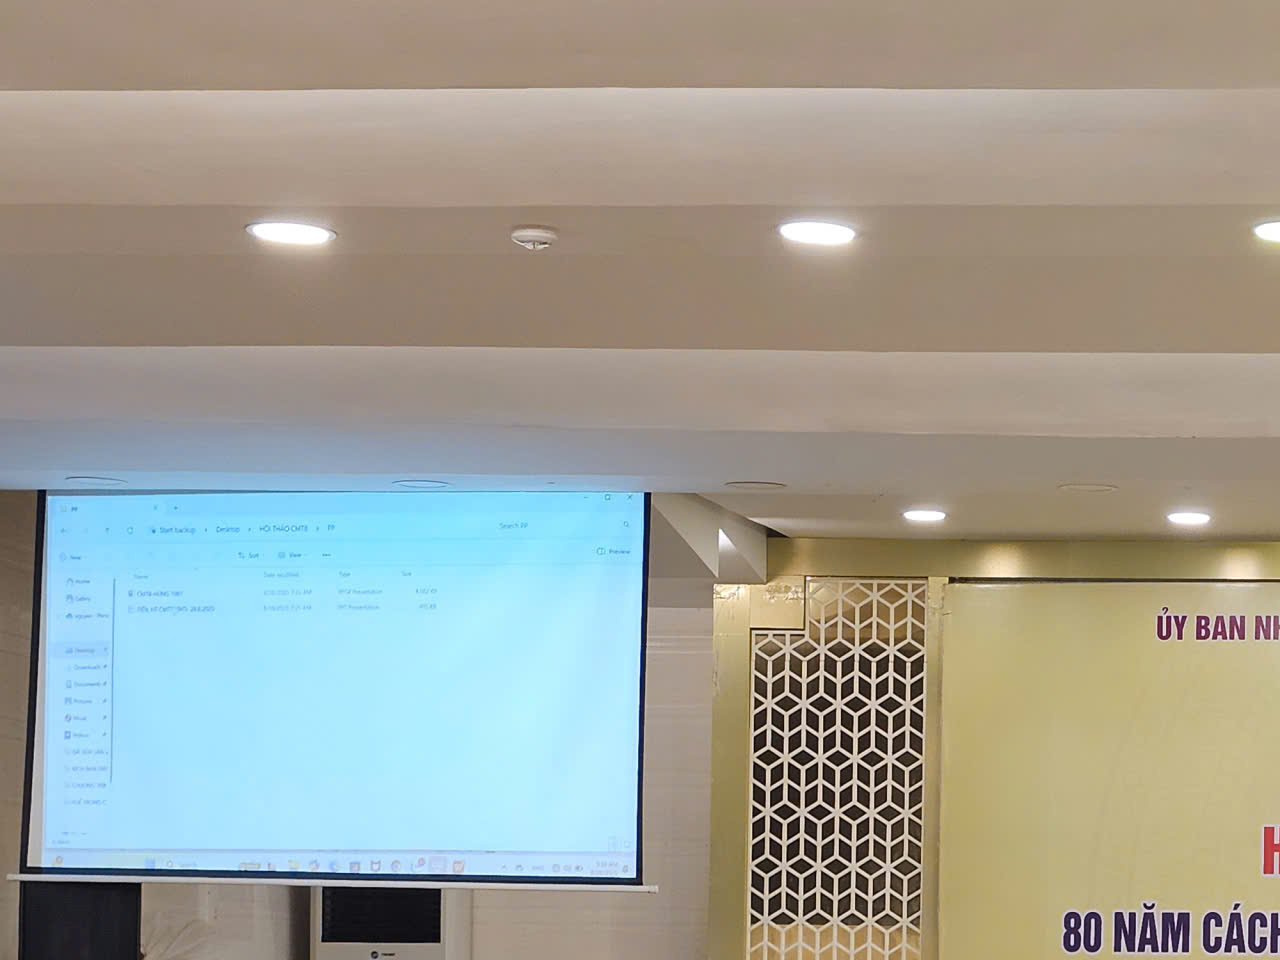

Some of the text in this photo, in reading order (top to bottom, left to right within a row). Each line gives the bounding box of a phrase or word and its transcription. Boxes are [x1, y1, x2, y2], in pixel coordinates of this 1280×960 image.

[1157, 607, 1187, 640] ỦY
[1196, 616, 1245, 640] BAN
[1064, 912, 1102, 952] 80
[1114, 903, 1190, 952] NĂM
